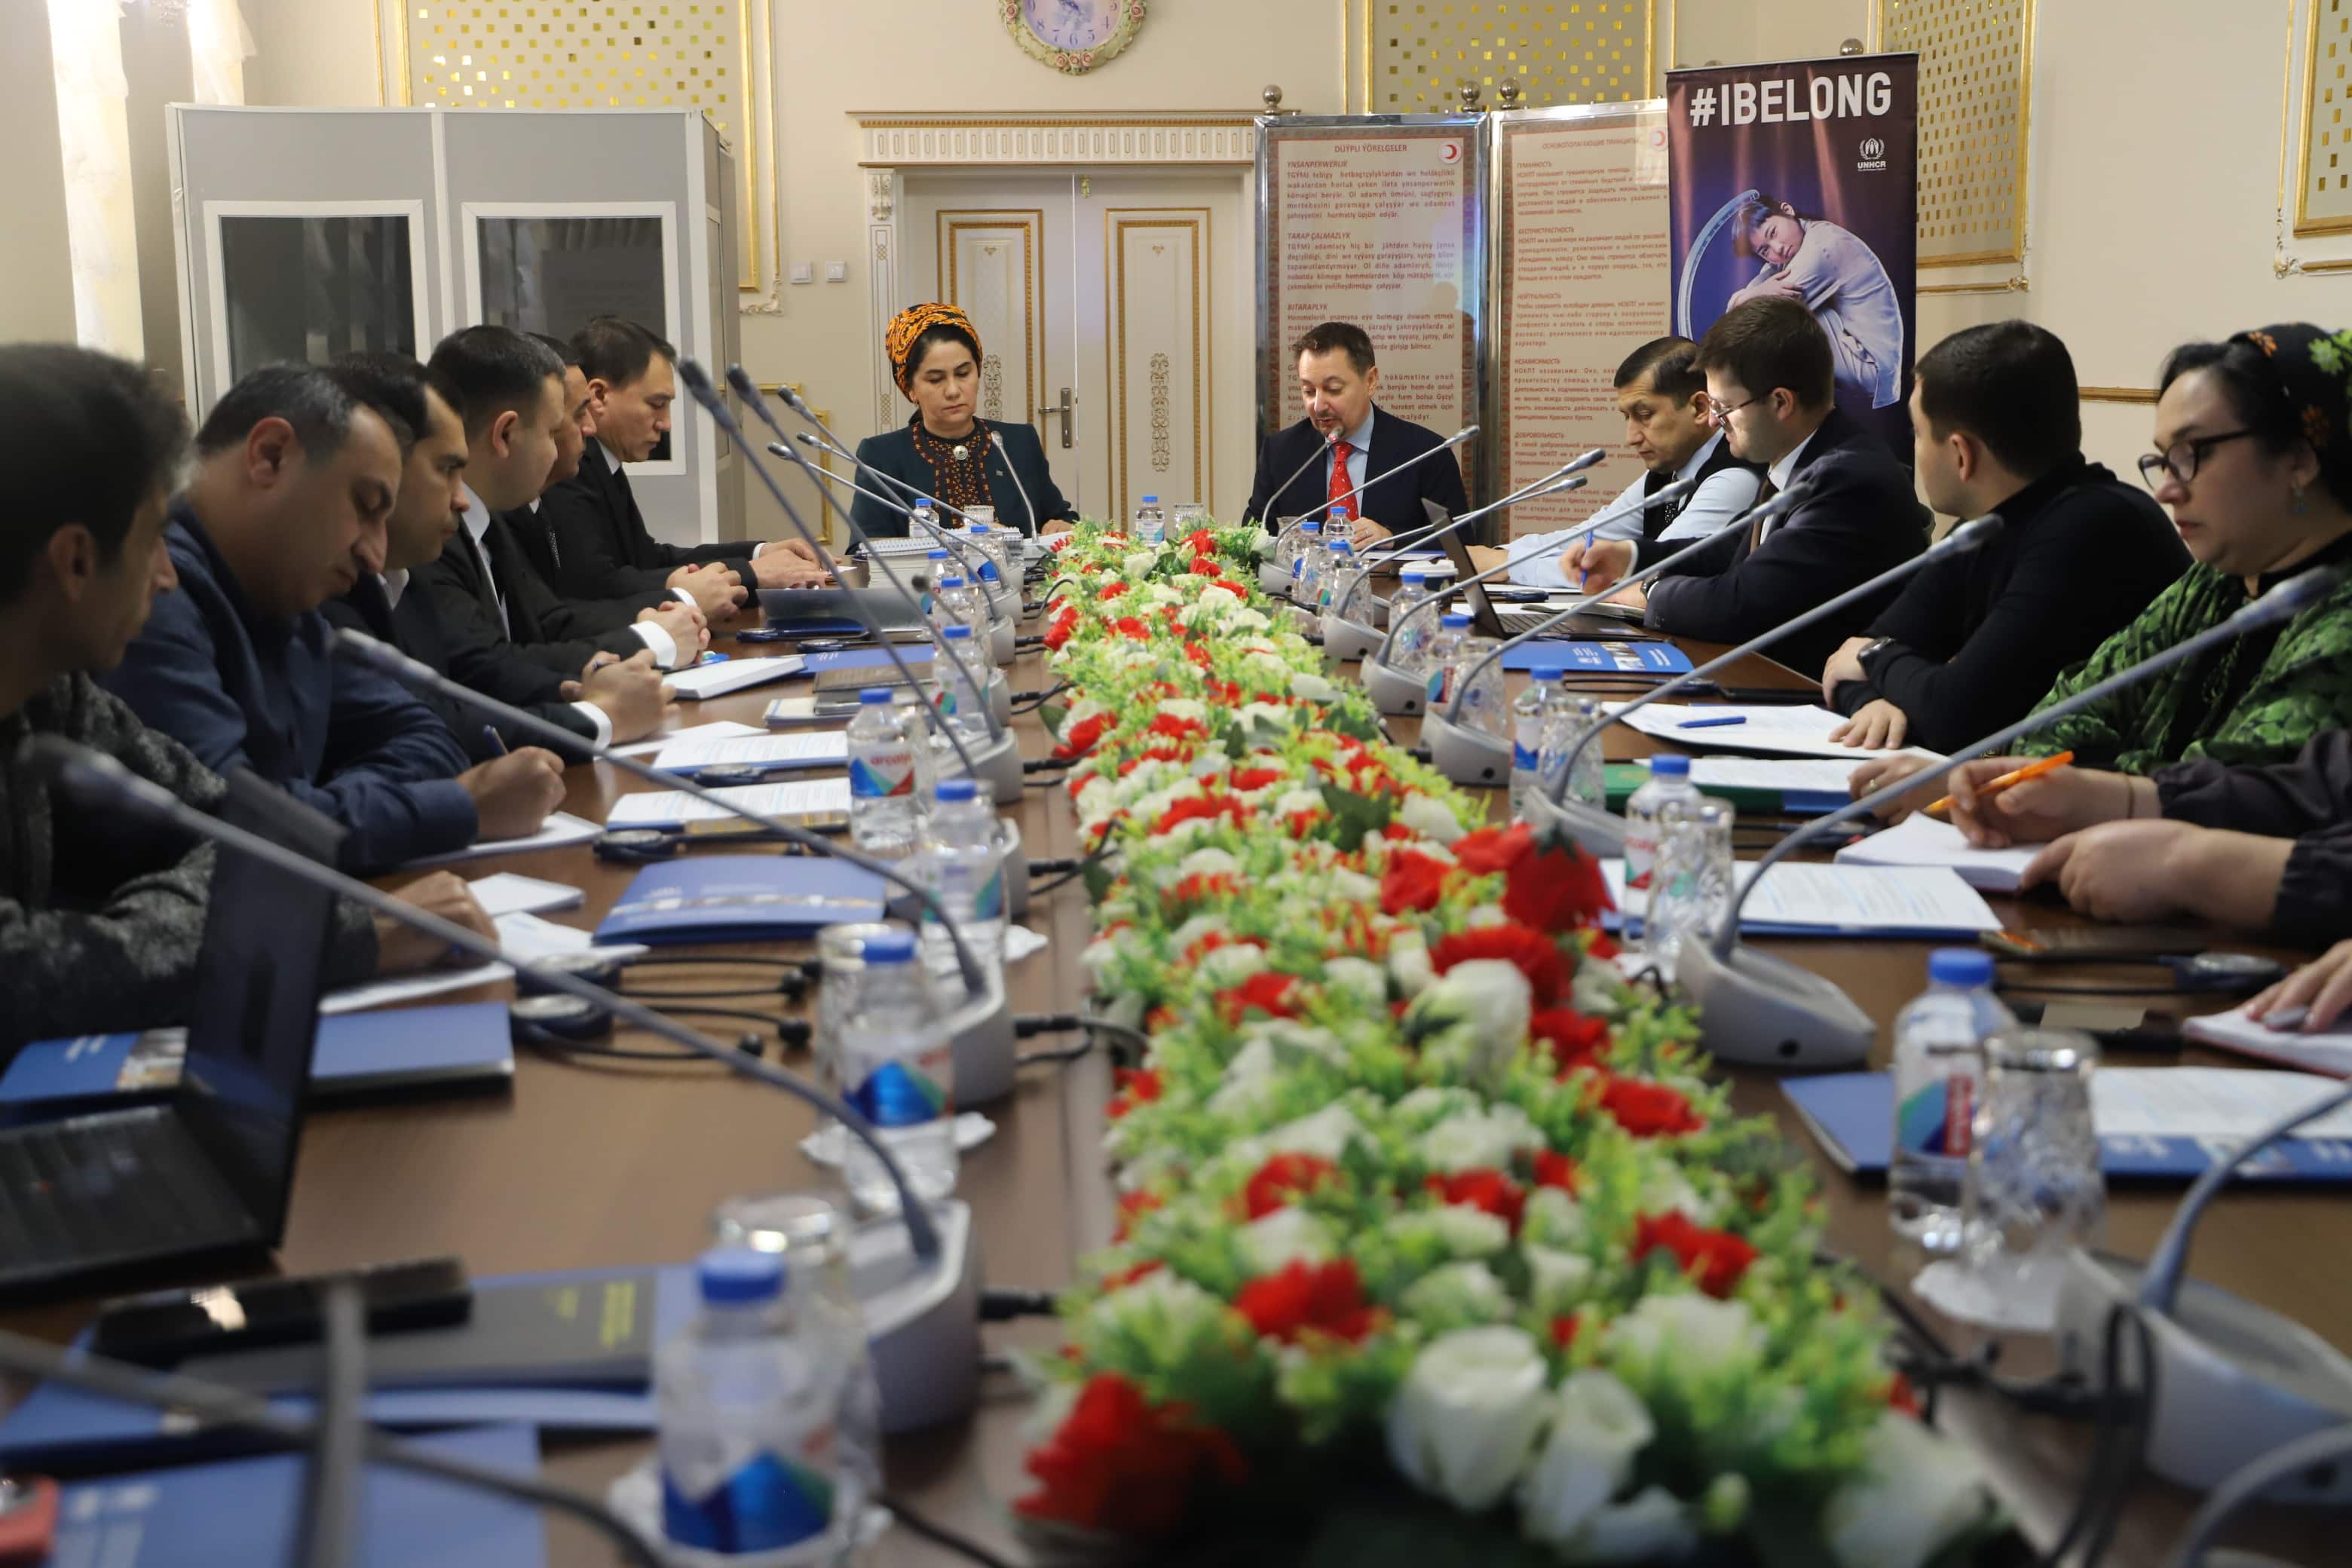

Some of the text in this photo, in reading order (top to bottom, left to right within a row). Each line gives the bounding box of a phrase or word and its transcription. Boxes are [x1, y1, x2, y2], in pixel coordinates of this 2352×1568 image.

[1069, 32, 1078, 45] 6
[1689, 72, 1891, 127] #IBELONG
[1857, 161, 1886, 169] UNHCR
